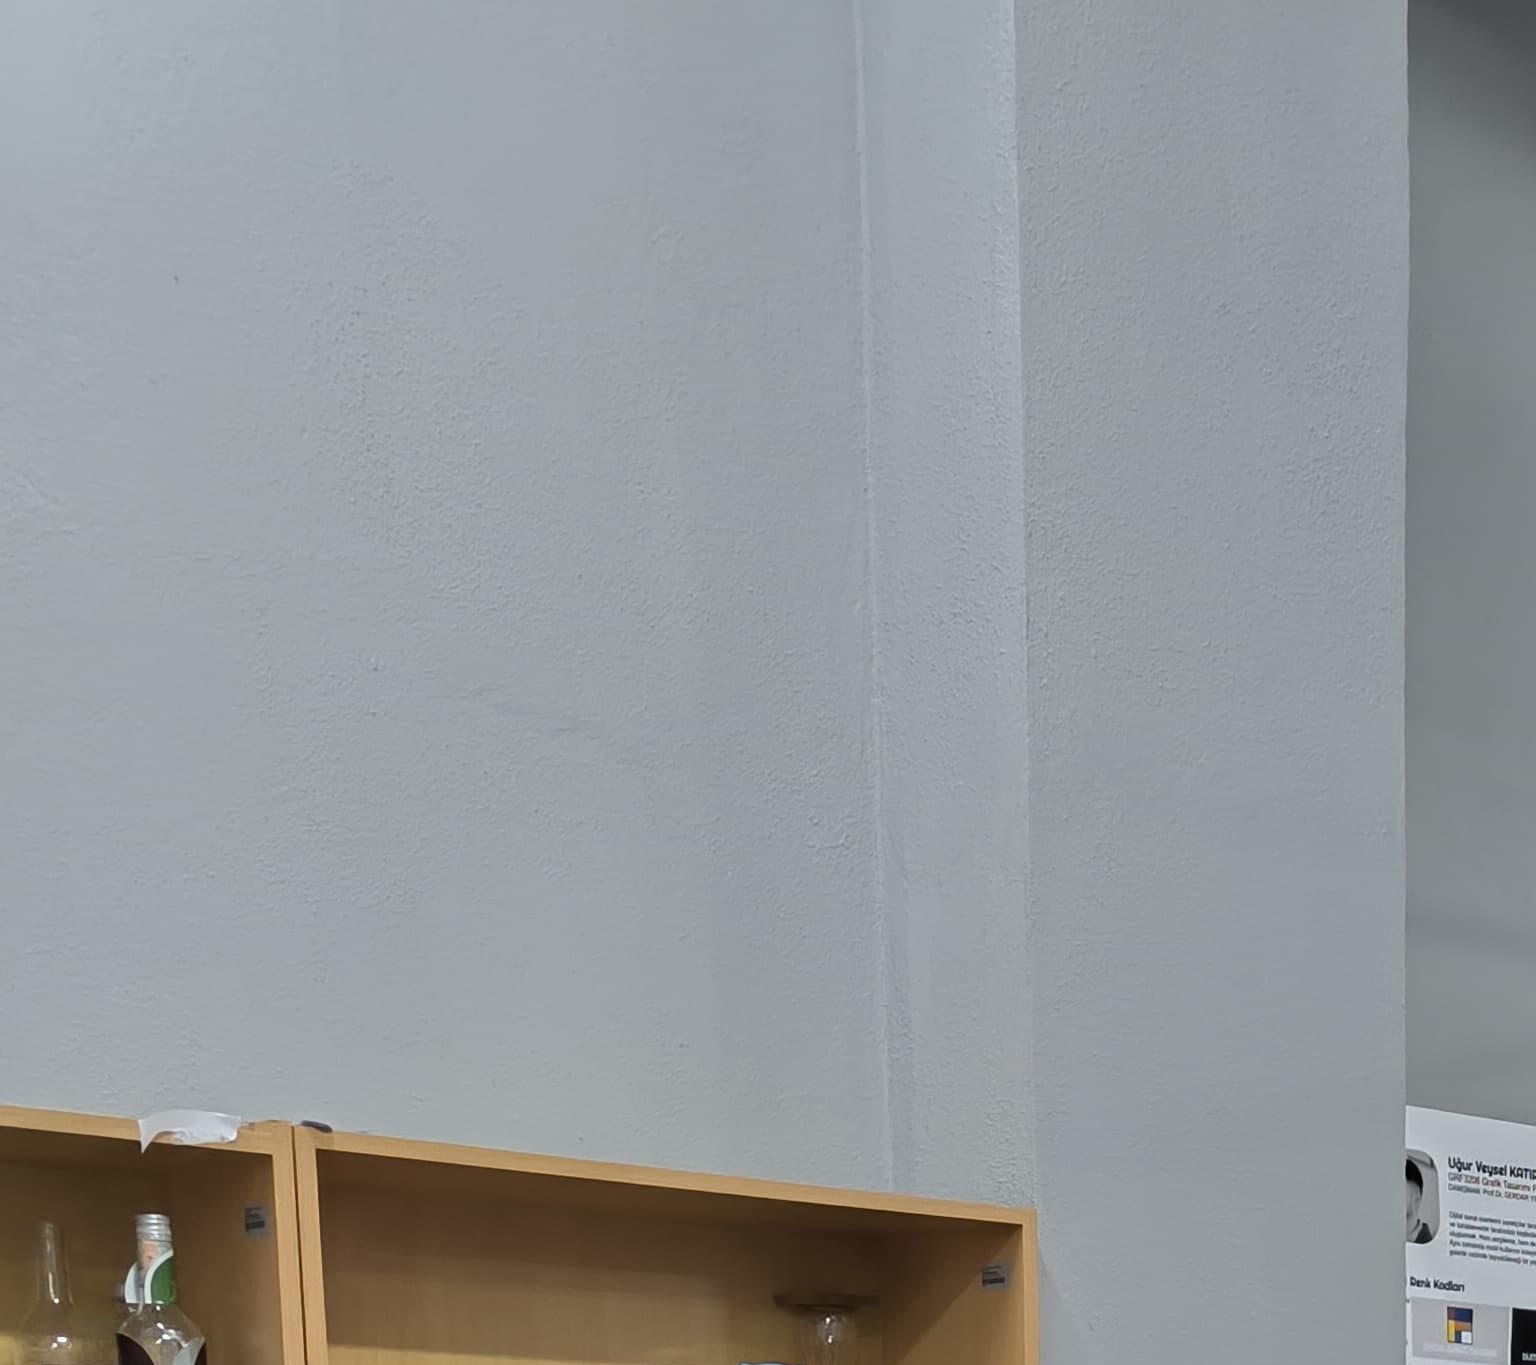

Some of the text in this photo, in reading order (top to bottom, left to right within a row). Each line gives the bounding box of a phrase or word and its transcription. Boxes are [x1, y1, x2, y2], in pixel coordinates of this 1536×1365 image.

[1448, 1157, 1473, 1172] Uğur
[1475, 1161, 1507, 1176] Veysel
[1410, 1277, 1431, 1287] Renk
